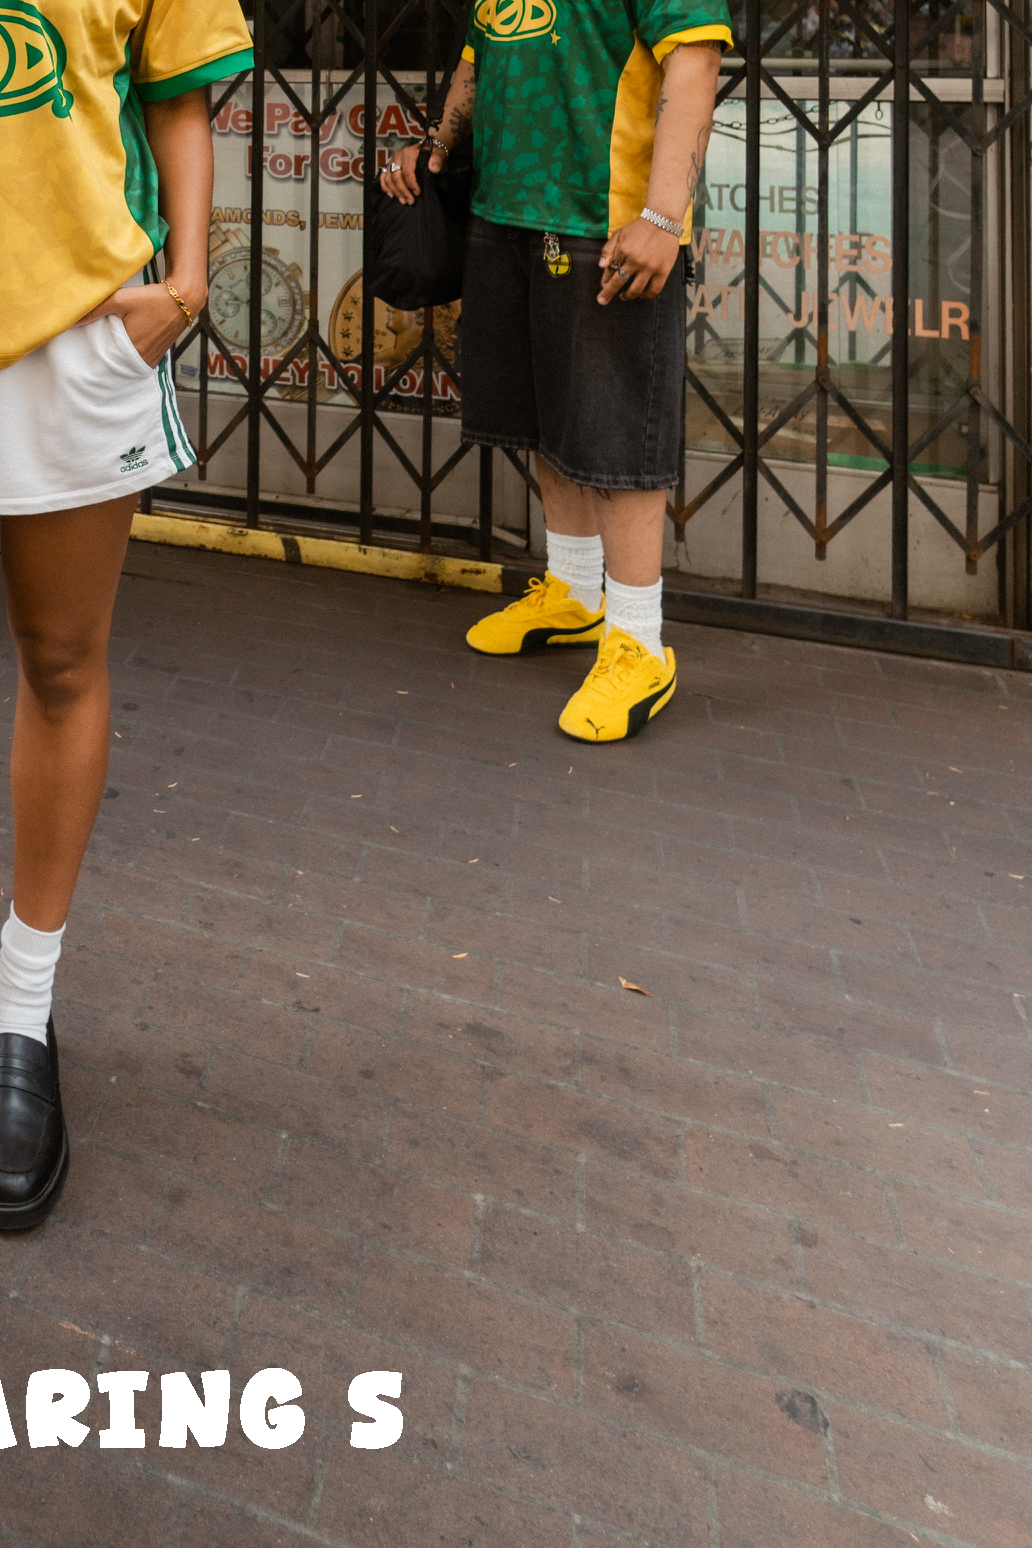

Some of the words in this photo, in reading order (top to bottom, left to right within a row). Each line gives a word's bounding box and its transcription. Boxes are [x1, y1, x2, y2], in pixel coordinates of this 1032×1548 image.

[264, 101, 339, 144] Pay
[348, 103, 428, 138] CAS
[211, 206, 307, 232] AMONDS,
[787, 290, 970, 341] JEWELR
[207, 352, 310, 387] MONEY
[318, 360, 363, 391] TO
[120, 459, 149, 473] adidas
